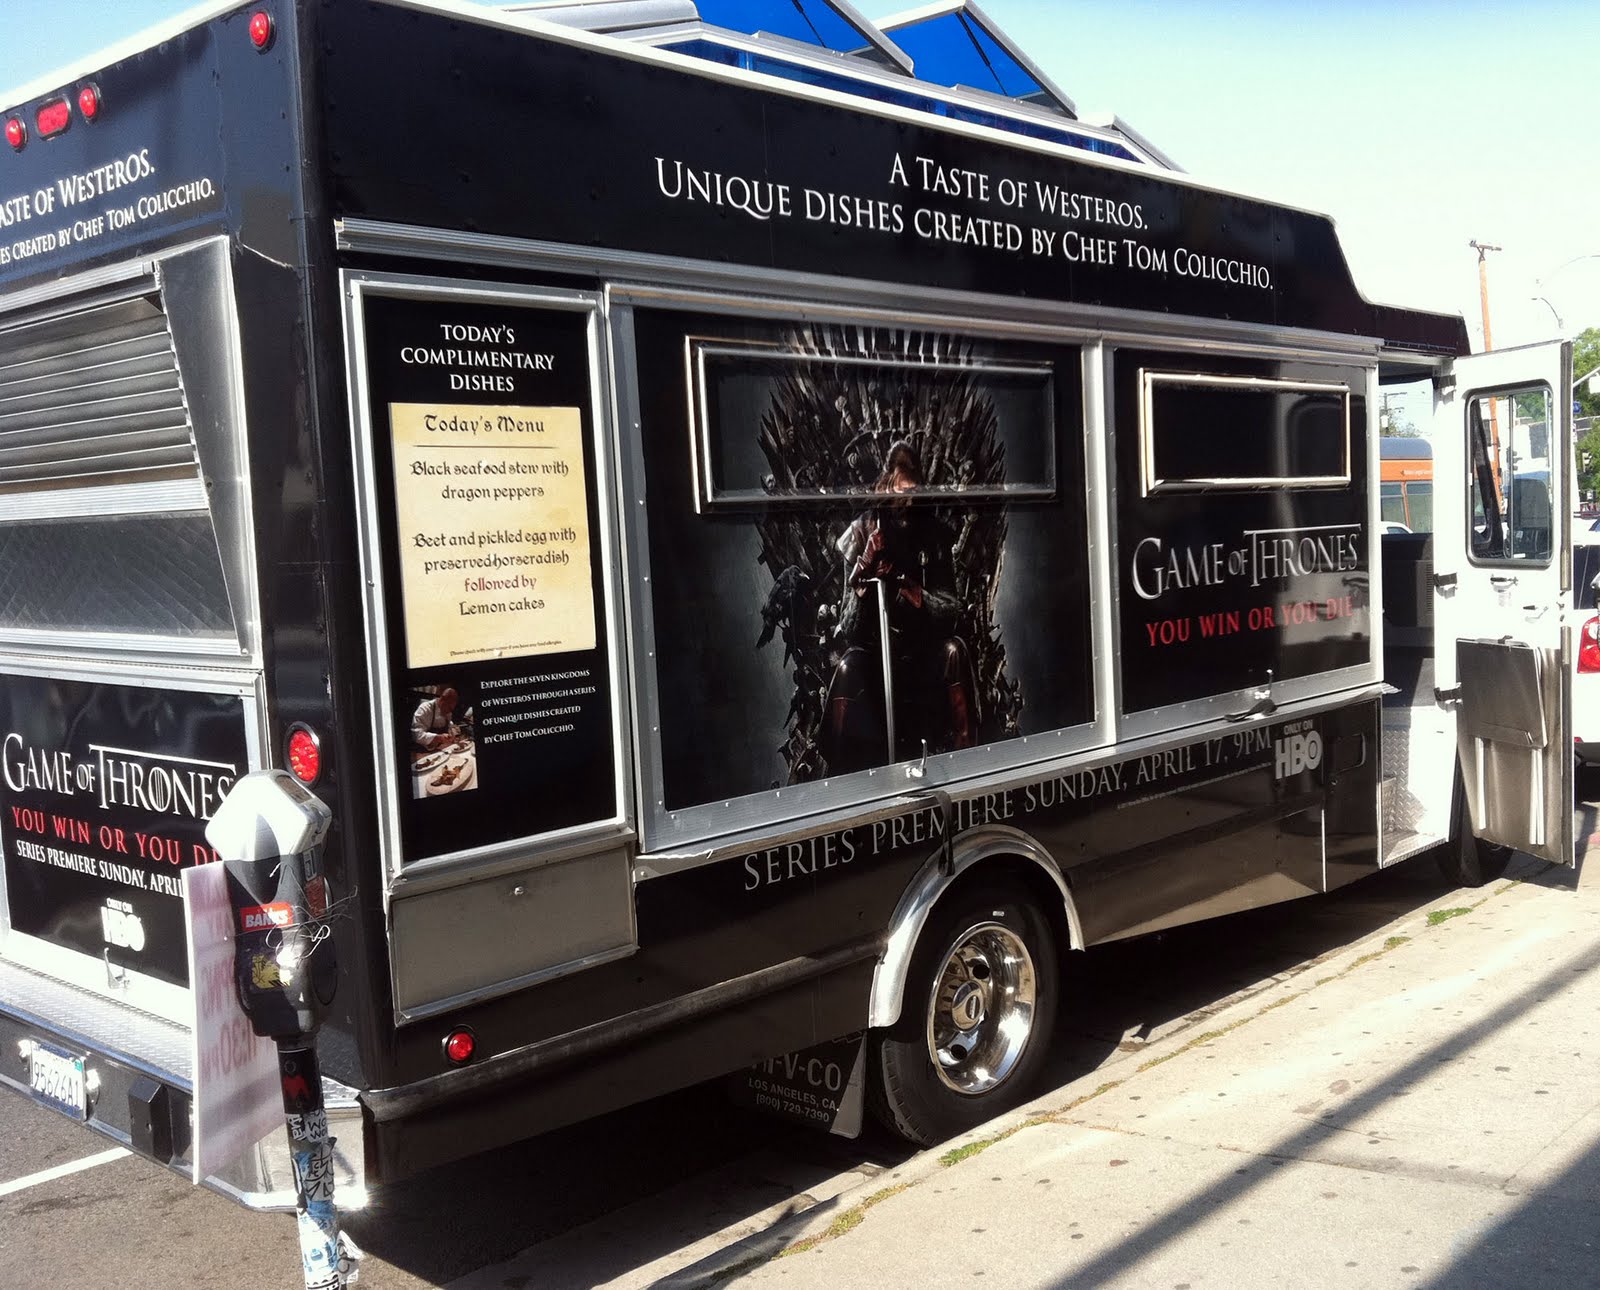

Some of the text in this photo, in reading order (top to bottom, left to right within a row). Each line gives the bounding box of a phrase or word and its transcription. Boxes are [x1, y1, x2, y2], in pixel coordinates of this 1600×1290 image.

[34, 187, 55, 216] OF
[57, 149, 155, 208] WESTEROS.
[889, 152, 1149, 230] A TASTE OF WESTEROS.
[12, 233, 56, 260] CREATED
[58, 227, 71, 247] BY
[73, 216, 104, 241] CHEF
[106, 204, 135, 231] TOM
[137, 178, 216, 221] COLICCHIO.
[654, 156, 1274, 290] UNIQUE DISHES CREATED BY CHEF TOM COLICCHIO.
[440, 324, 515, 344] TODAY'S
[400, 347, 555, 370] COMPLIMENTARY
[450, 374, 515, 392] DISHES
[424, 414, 545, 435] Today's Menu
[410, 460, 569, 477] Black seafood stew with
[441, 485, 545, 502] dragon peppers
[412, 527, 577, 548] Beet and pickled egg with
[424, 551, 570, 574] preserved horseradish
[1132, 523, 1362, 600] GAME OF THRONES
[464, 575, 537, 592] followed by
[459, 597, 545, 616] Lemon cakes
[1146, 596, 1353, 646] YOU WIN OR YOU DIE
[480, 669, 591, 689] EXPLORE THE SEVEN KINGDOMS
[481, 699, 492, 708] OF
[492, 694, 532, 706] WESTEROS
[531, 689, 569, 701] THROUGH
[574, 685, 597, 696] SERIES
[482, 705, 581, 727] OF UNIQUE DISHES CREATED
[1283, 719, 1314, 735] ONLY ON
[484, 736, 494, 745] BY
[493, 732, 514, 743] CHEF
[514, 730, 532, 740] TOM
[2, 732, 74, 796] GAME
[76, 763, 96, 793] OF
[1275, 730, 1323, 780] HBO
[743, 828, 856, 891] SERIES
[871, 789, 1016, 855] PREMIERE
[1024, 762, 1128, 813] SUNDAY,
[1136, 742, 1197, 786] APRIL
[1234, 726, 1273, 758] 9PM
[12, 806, 45, 834] YOU
[52, 814, 91, 845] WIN
[99, 825, 128, 854] OR
[135, 832, 181, 865] YOU
[16, 839, 184, 898] SERIES PREMIERE SUNDAY, APRIL
[748, 1078, 768, 1092] LOS
